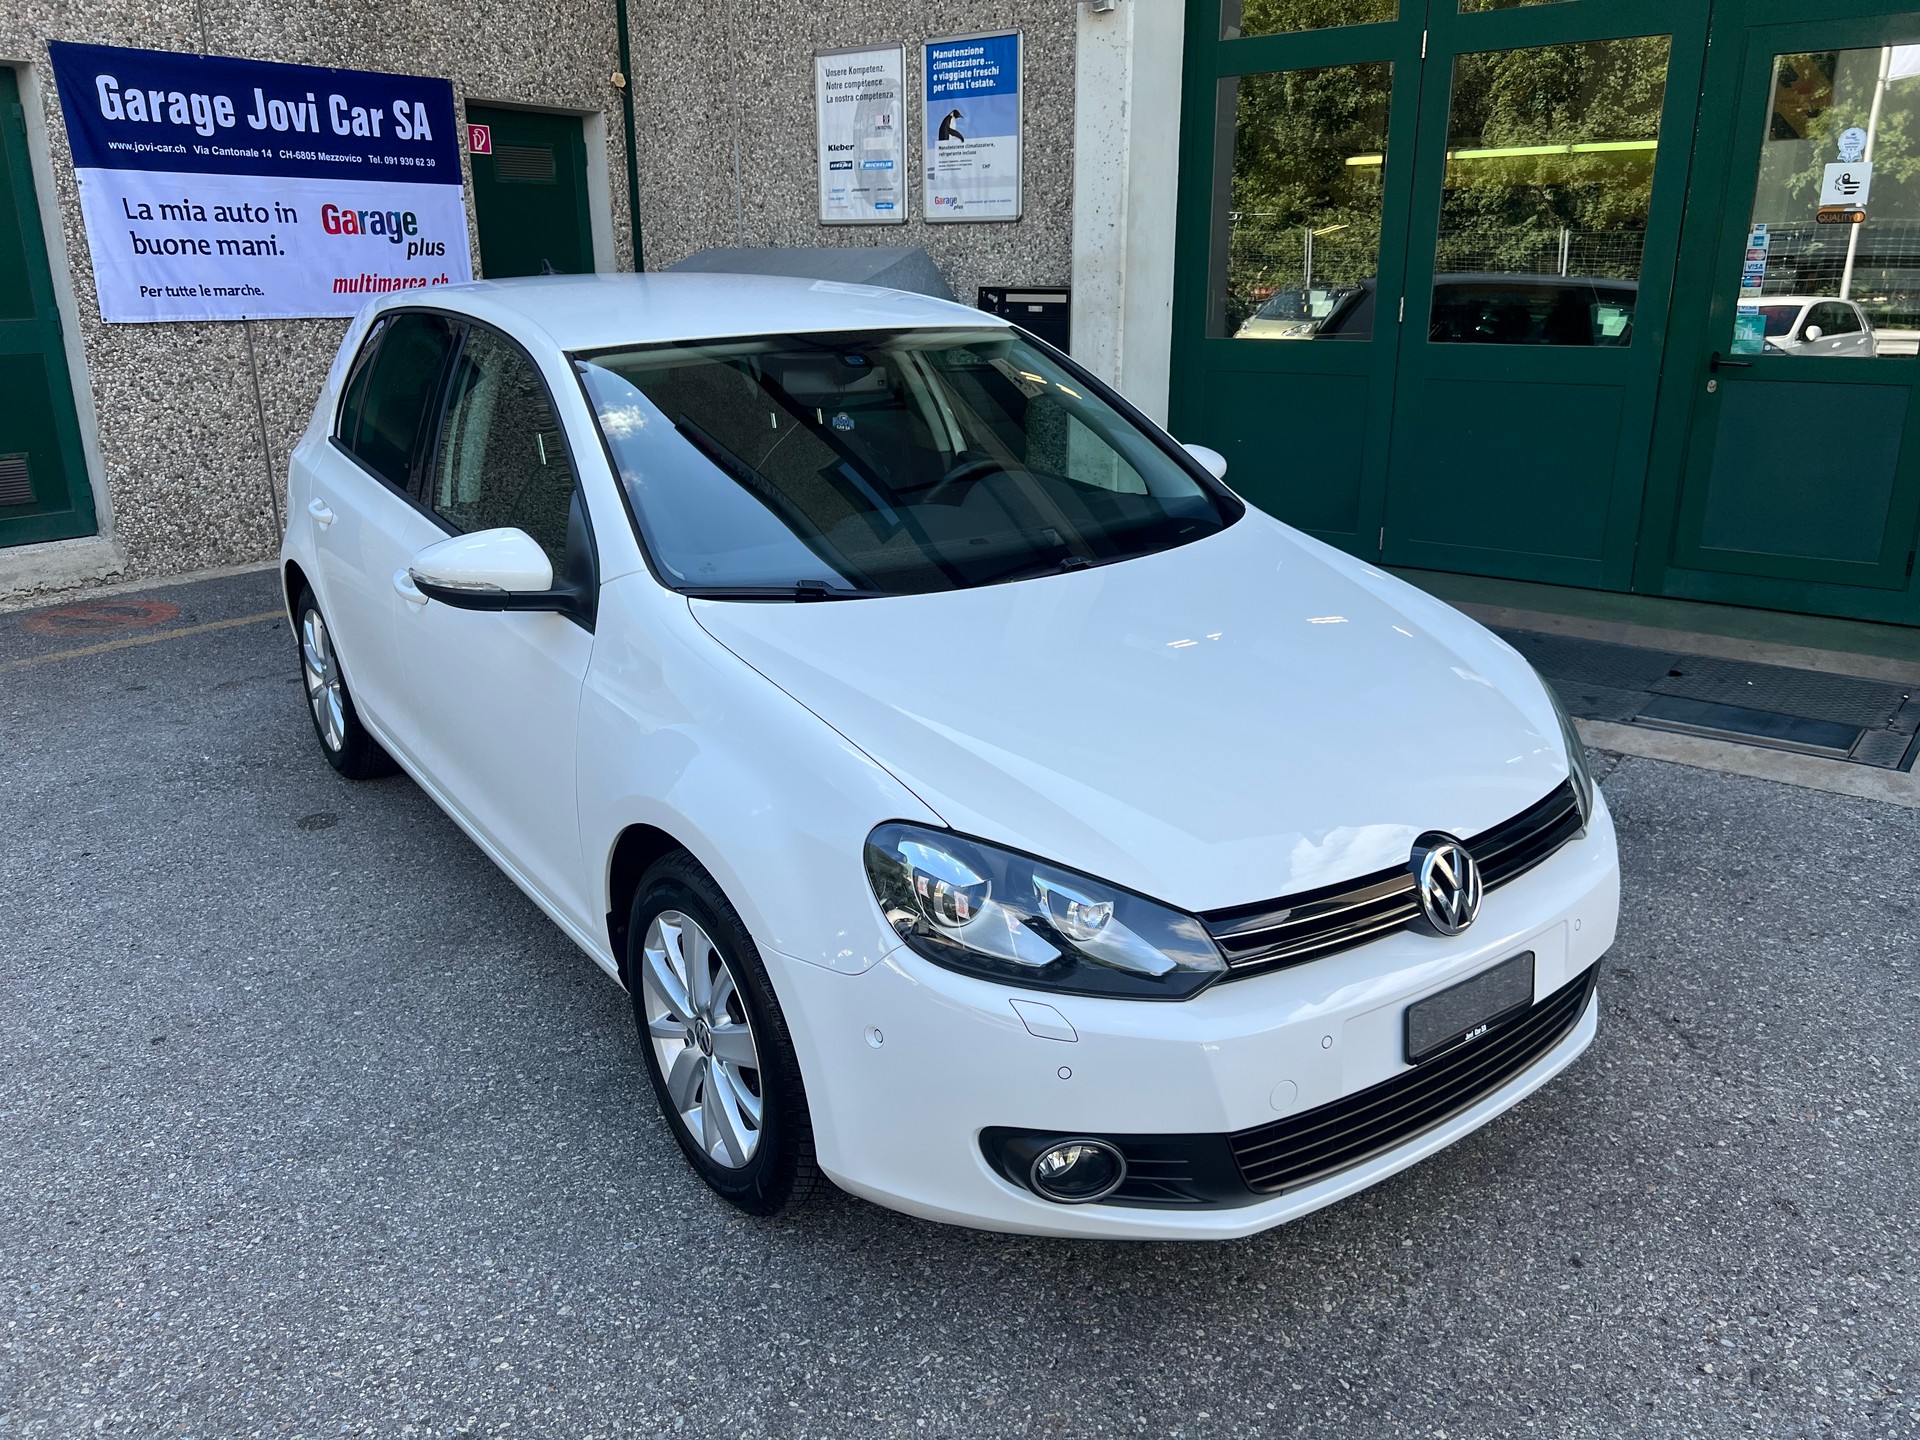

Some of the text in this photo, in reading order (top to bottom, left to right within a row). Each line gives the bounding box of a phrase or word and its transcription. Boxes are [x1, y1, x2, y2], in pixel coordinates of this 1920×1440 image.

[933, 47, 984, 59] Manutenzione
[826, 65, 885, 77] Unsere Kompetenz.
[933, 59, 994, 70] climatizzatore...
[939, 70, 972, 81] viaggiate
[973, 66, 999, 76] freschi
[826, 82, 843, 90] Notre
[933, 79, 996, 94] per tutta l'estate.
[826, 92, 896, 103] La nostra competenza.
[95, 75, 432, 141] Garage Jovi Car SA
[108, 141, 435, 167] www.jovi-car.ch Via Cantonale 14 CH-6805 Mezzovico Tel. 091 930 62 30
[935, 196, 957, 206] Garage
[122, 198, 297, 223] La mia auto in
[321, 204, 418, 244] Garage
[1818, 214, 1853, 223] QUALITY
[129, 231, 284, 256] buone mani.
[407, 238, 445, 260] plus
[140, 284, 265, 297] Per tutte le marche.
